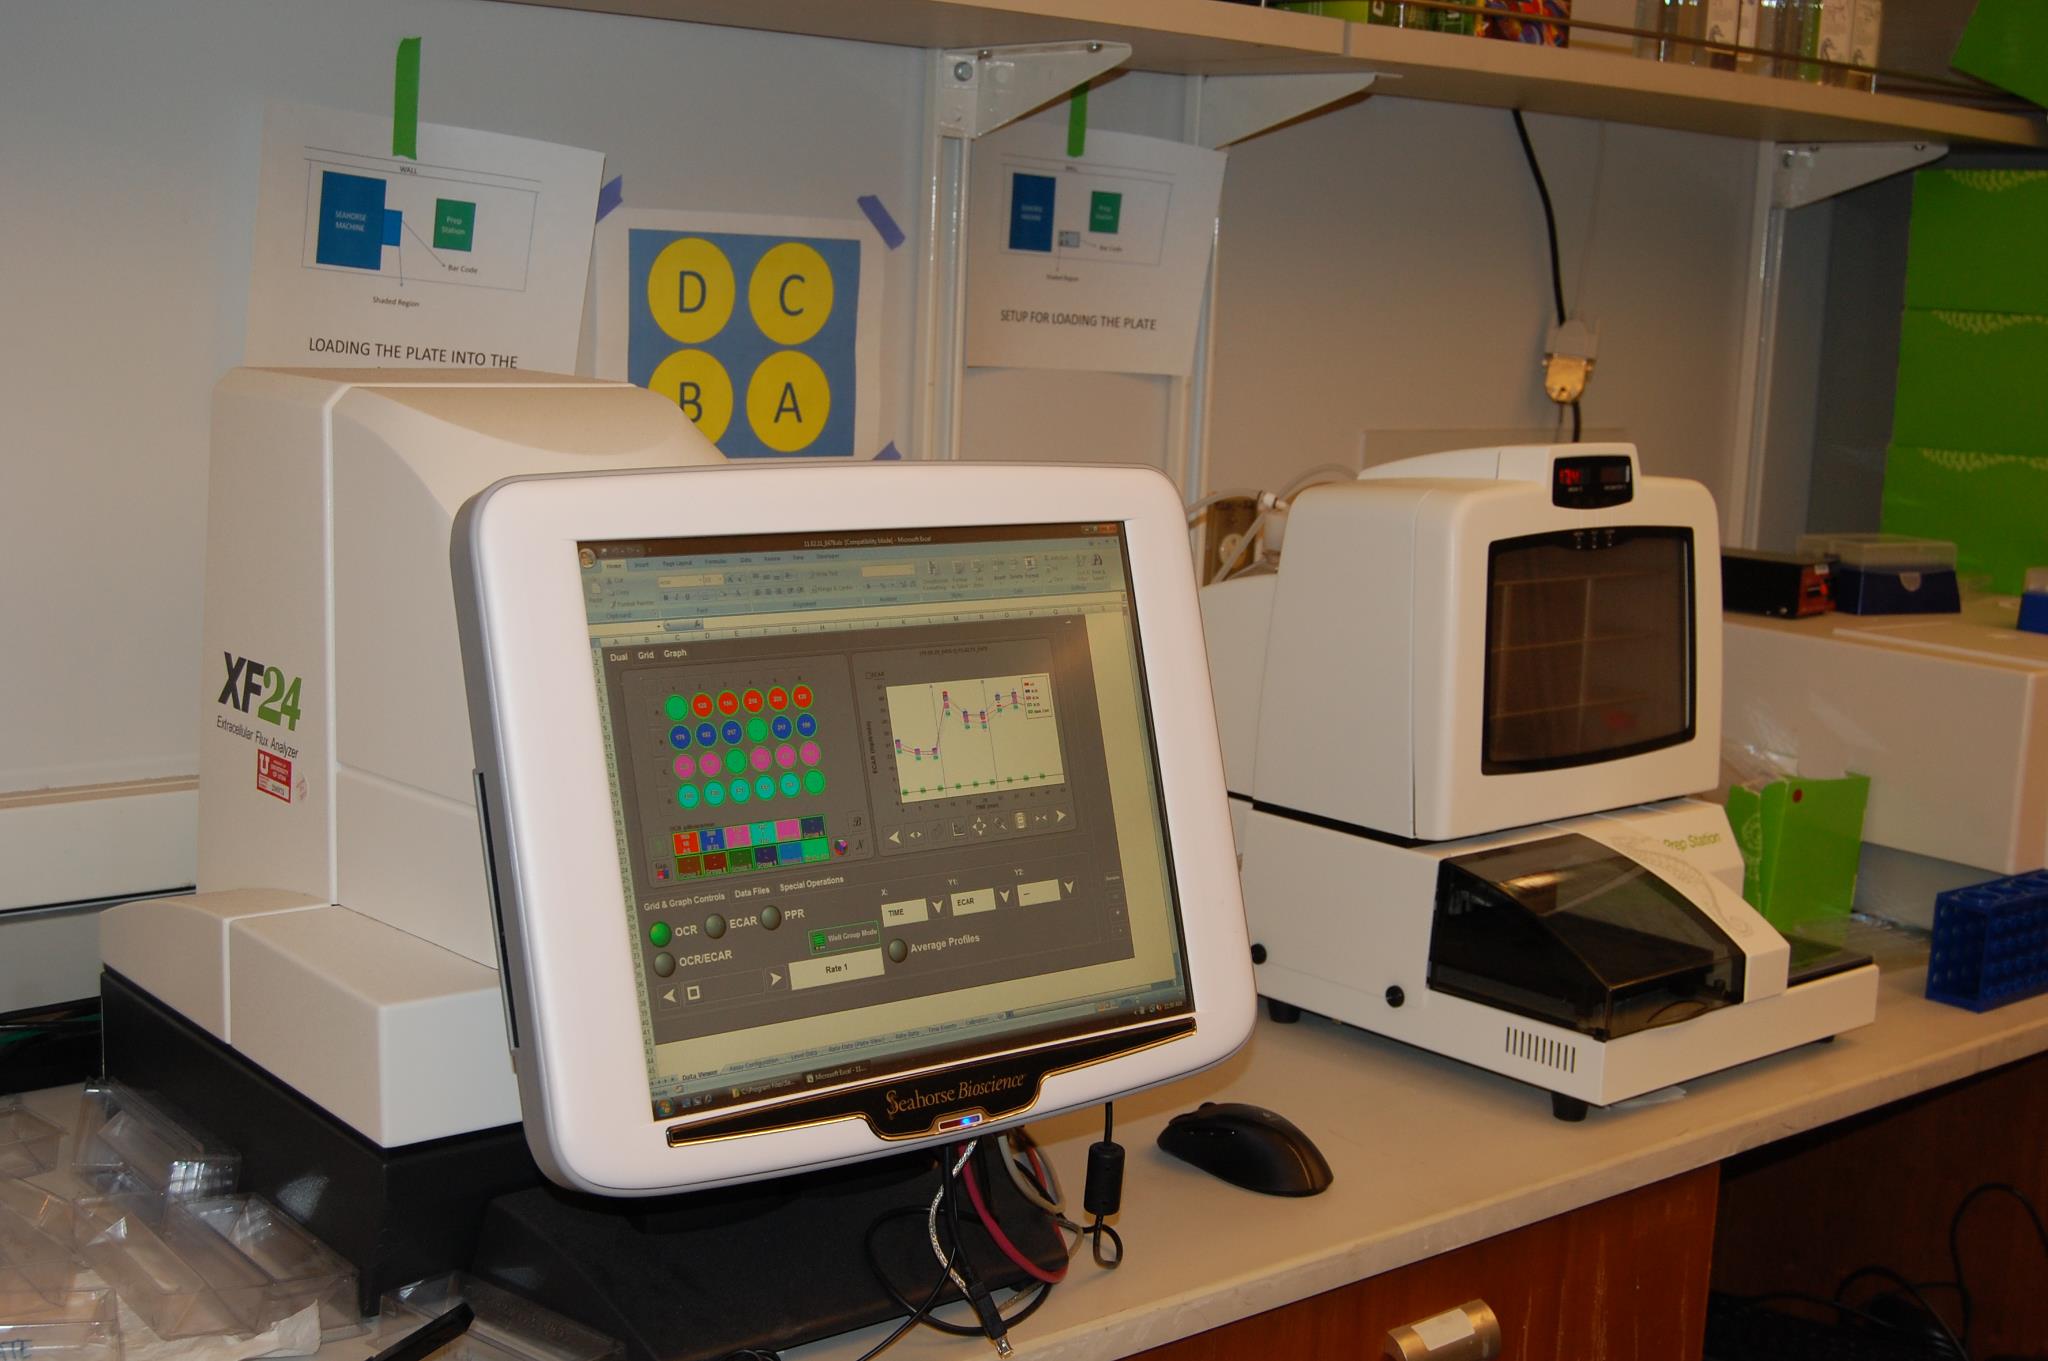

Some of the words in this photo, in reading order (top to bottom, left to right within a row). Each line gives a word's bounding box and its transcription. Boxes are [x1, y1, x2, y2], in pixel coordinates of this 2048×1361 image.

[400, 166, 418, 175] WALL
[335, 210, 367, 222] SEAHORSE
[446, 216, 462, 227] Prep
[335, 221, 365, 233] MACHINE
[441, 226, 466, 236] Station
[448, 265, 460, 273] Bar
[460, 265, 478, 275] Code
[678, 270, 707, 314] D
[779, 274, 806, 316] C
[372, 296, 397, 307] Shaded
[398, 297, 420, 309] Region
[1000, 309, 1028, 322] SETUP
[1030, 311, 1049, 324] FOR
[1052, 313, 1097, 327] LOADING
[1101, 316, 1120, 328] THE
[1123, 317, 1157, 330] PLATE
[309, 337, 371, 357] LOADING
[375, 343, 402, 359] THE
[406, 346, 447, 363] PLATE
[451, 351, 486, 366] INTO
[491, 354, 518, 369] THE
[680, 381, 703, 424] B
[773, 381, 803, 424] A
[610, 653, 628, 662] Dual
[638, 651, 655, 660] Grid
[664, 648, 687, 658] Graph
[217, 651, 302, 731] XF24
[216, 715, 253, 741] Extracellular
[255, 730, 269, 747] Flux
[270, 736, 299, 759] Analyzer
[1688, 832, 1720, 848] Station
[735, 888, 751, 898] Data
[753, 886, 770, 896] Files
[779, 881, 804, 893] Special
[806, 876, 844, 889] Operations
[881, 888, 888, 896] X:
[644, 902, 660, 911] Grid
[661, 901, 668, 909] &
[669, 897, 692, 909] Graph
[694, 893, 725, 905] Controls
[888, 908, 904, 917] TIME
[957, 898, 974, 906] ECAR
[675, 925, 697, 937] OCR
[730, 916, 757, 929] ECAR
[785, 909, 805, 921] PPR
[843, 931, 860, 942] Group
[862, 928, 877, 937] Mode
[911, 937, 946, 953] Average
[948, 934, 980, 947] Profiles
[679, 950, 733, 967] OCR/ECAR
[826, 964, 841, 974] Rate
[681, 1073, 696, 1081] Data
[698, 1070, 718, 1078] Viewer
[815, 1071, 838, 1080] Microsoft
[886, 1089, 955, 1120] Seahorse
[958, 1073, 1025, 1100] Bioscience
